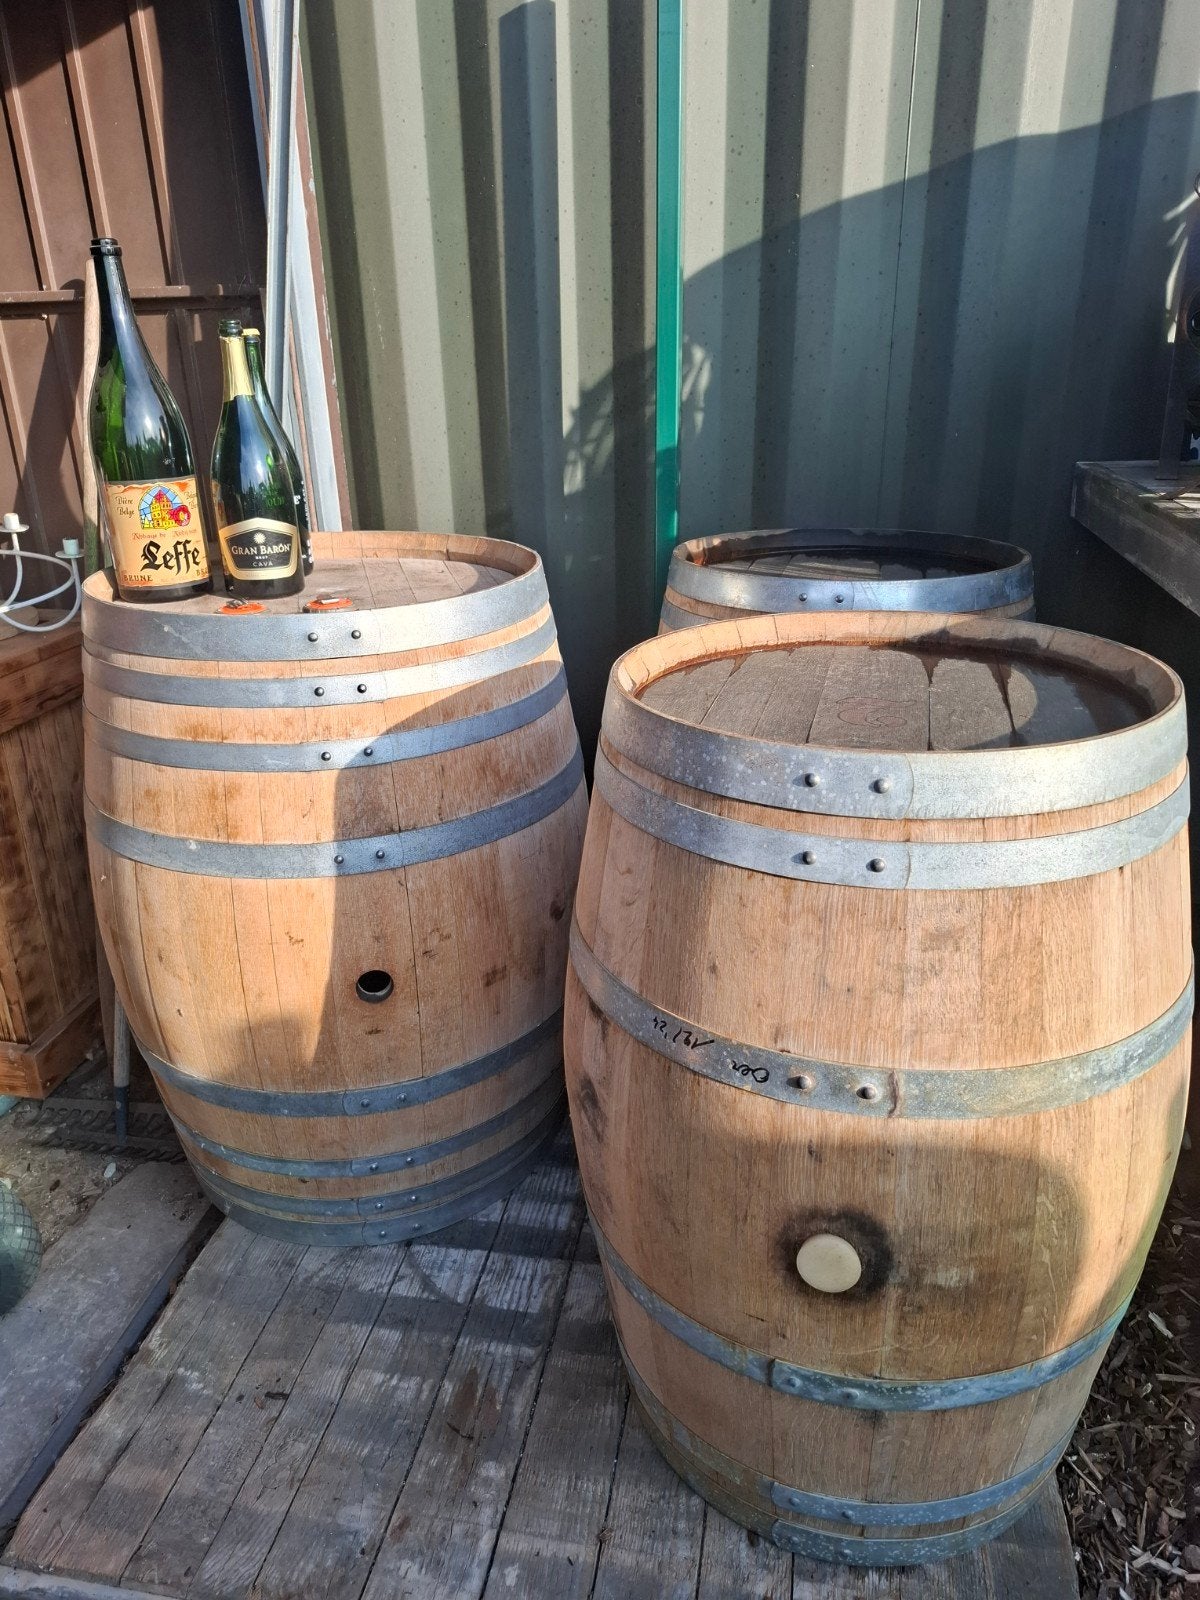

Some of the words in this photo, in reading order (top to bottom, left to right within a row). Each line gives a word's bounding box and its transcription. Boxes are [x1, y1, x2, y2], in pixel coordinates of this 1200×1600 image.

[117, 507, 135, 518] Belge
[231, 545, 257, 554] GRAN
[260, 543, 290, 555] BARÓN
[140, 540, 201, 576] Leffe
[123, 574, 153, 582] BRUNE
